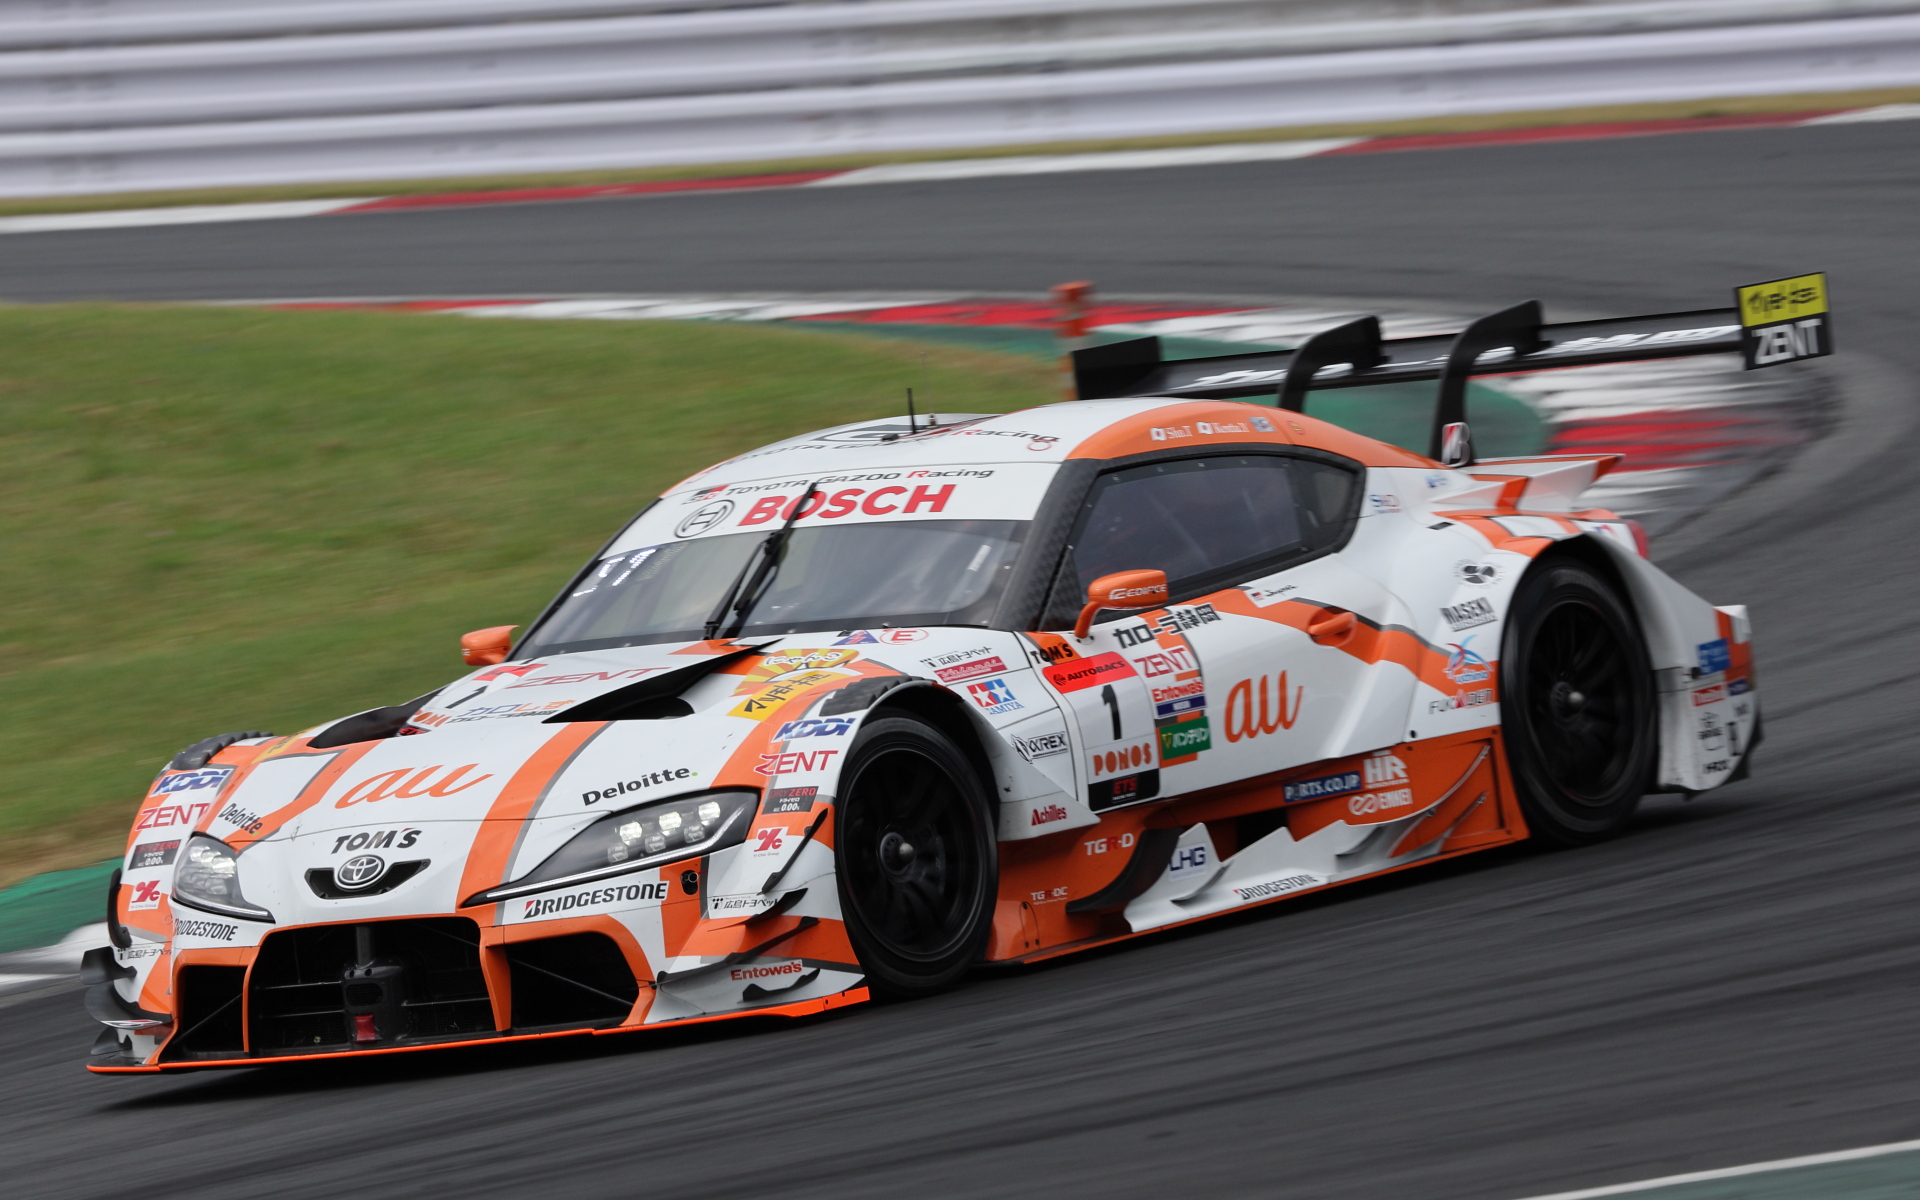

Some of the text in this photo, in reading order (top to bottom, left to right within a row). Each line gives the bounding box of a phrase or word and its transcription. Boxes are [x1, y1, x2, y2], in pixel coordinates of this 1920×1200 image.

[1751, 318, 1822, 365] ZENT
[725, 468, 996, 497] TOYOTA GAZOO Racing
[737, 484, 957, 527] BOSCH
[1030, 643, 1074, 664] TOM'S
[1134, 647, 1194, 678] ZENT
[506, 667, 671, 689] ZENT
[1067, 660, 1126, 682] AUTOBACS
[985, 701, 1025, 715] TAMIYA
[1101, 683, 1123, 741] 1
[1224, 670, 1304, 743] au
[773, 718, 856, 742] KDDI
[754, 750, 839, 776] ZENT
[1093, 742, 1152, 776] PONOS
[152, 769, 231, 797] KDDI
[334, 762, 492, 809] au
[788, 787, 817, 797] ZERO
[1113, 777, 1137, 795] ETS
[136, 803, 211, 831] ZENT
[1031, 804, 1067, 826] Achilles
[152, 841, 180, 852] ZERO
[330, 828, 423, 855] TOM'S
[1084, 832, 1134, 856] TGR-D
[1170, 846, 1206, 872] LHG
[523, 881, 668, 919] BRIDGESTONE
[1030, 886, 1068, 901] TGR-DC
[730, 961, 802, 981] Entowa's
